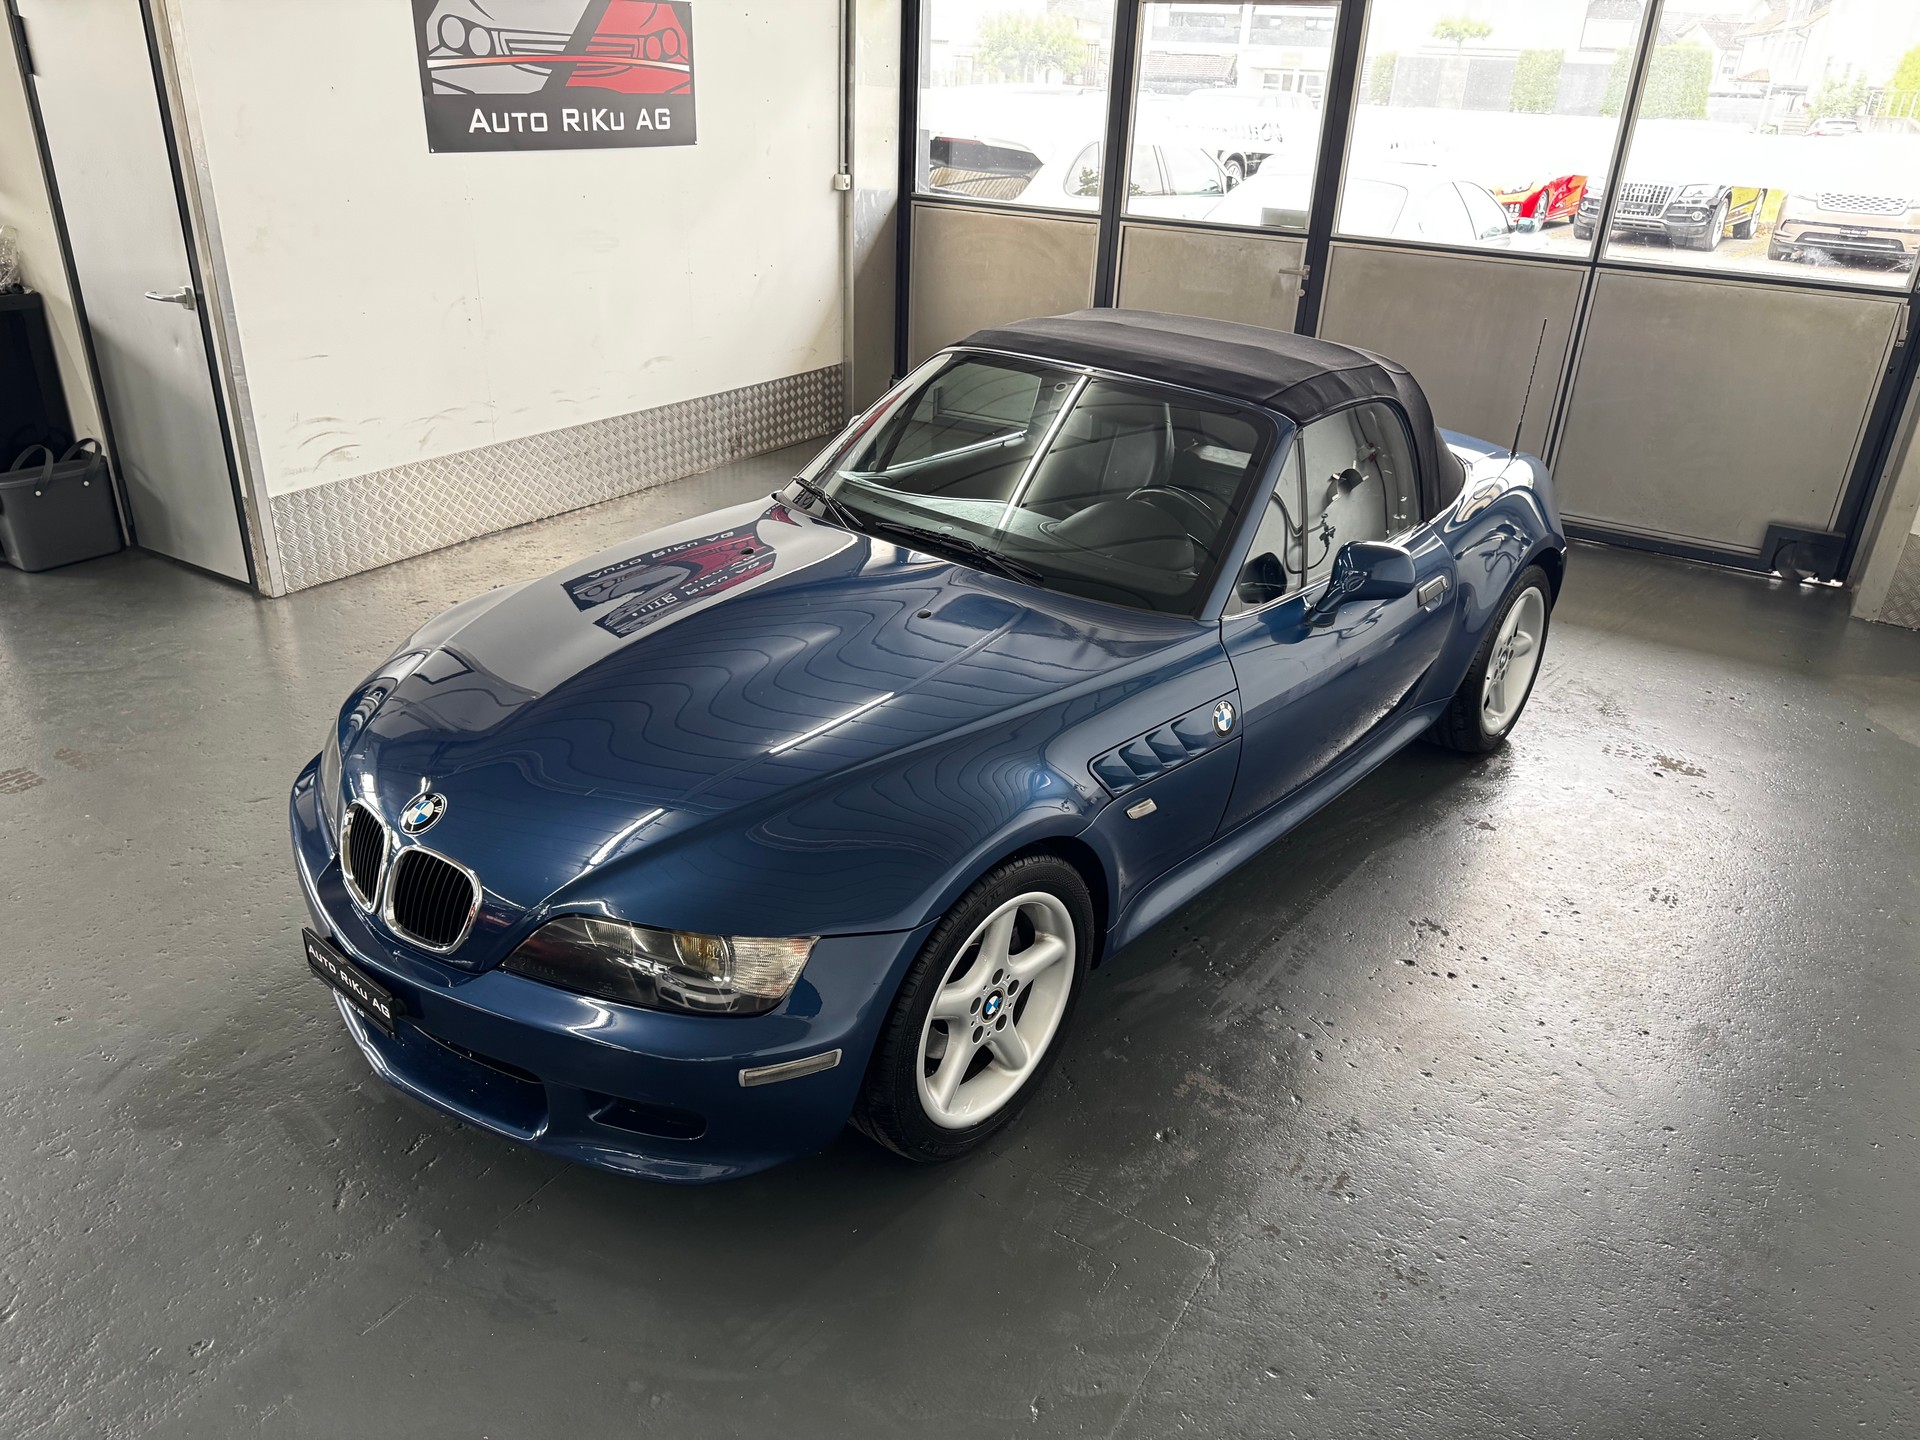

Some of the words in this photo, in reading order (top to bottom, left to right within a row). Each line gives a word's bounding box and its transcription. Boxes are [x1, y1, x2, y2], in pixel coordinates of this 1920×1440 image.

[468, 108, 548, 133] AUTO
[635, 107, 671, 131] AG
[308, 944, 337, 975] AUTO
[372, 997, 391, 1019] AG
